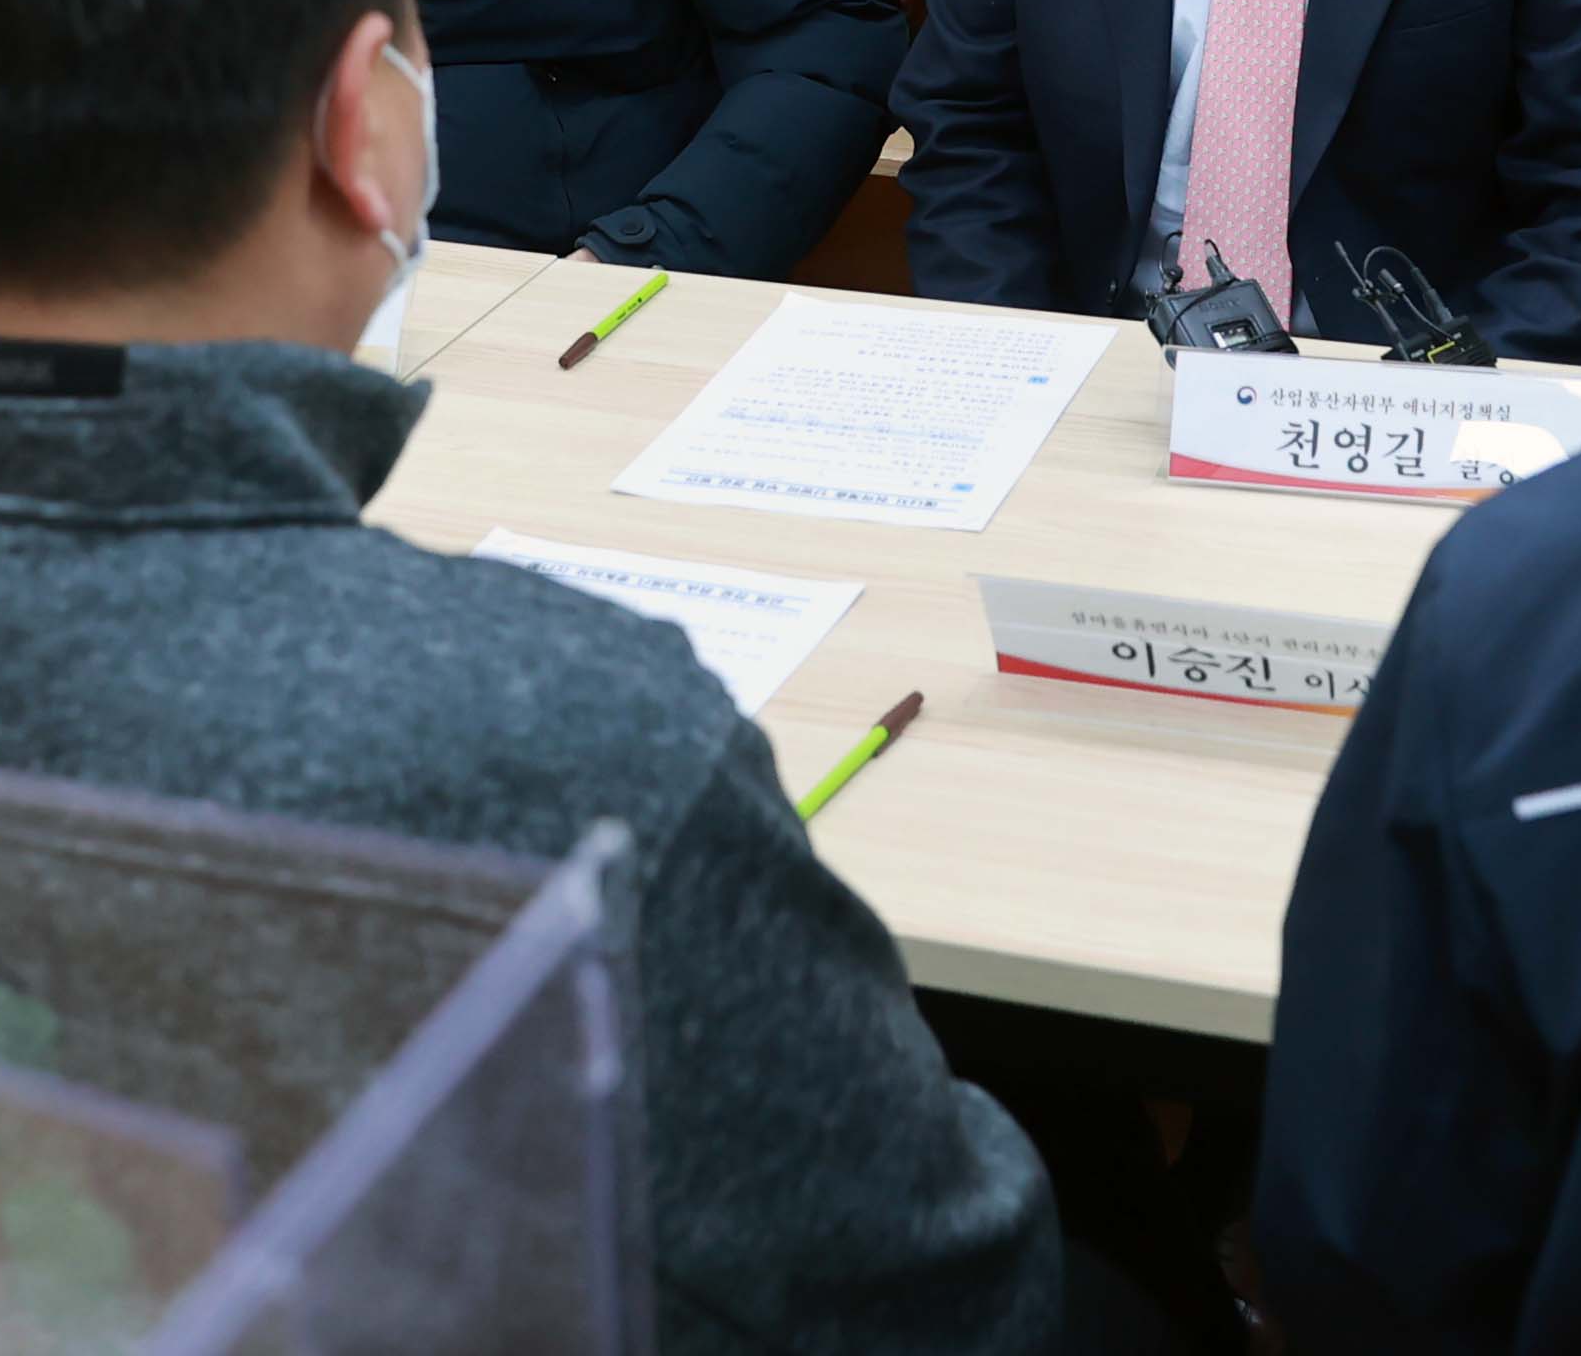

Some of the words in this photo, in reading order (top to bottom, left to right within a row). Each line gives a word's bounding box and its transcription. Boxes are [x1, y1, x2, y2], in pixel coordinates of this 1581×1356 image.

[1403, 398, 1512, 422] 에너지정책실
[1276, 418, 1426, 478] 천영길
[1111, 640, 1277, 693] 이승진
